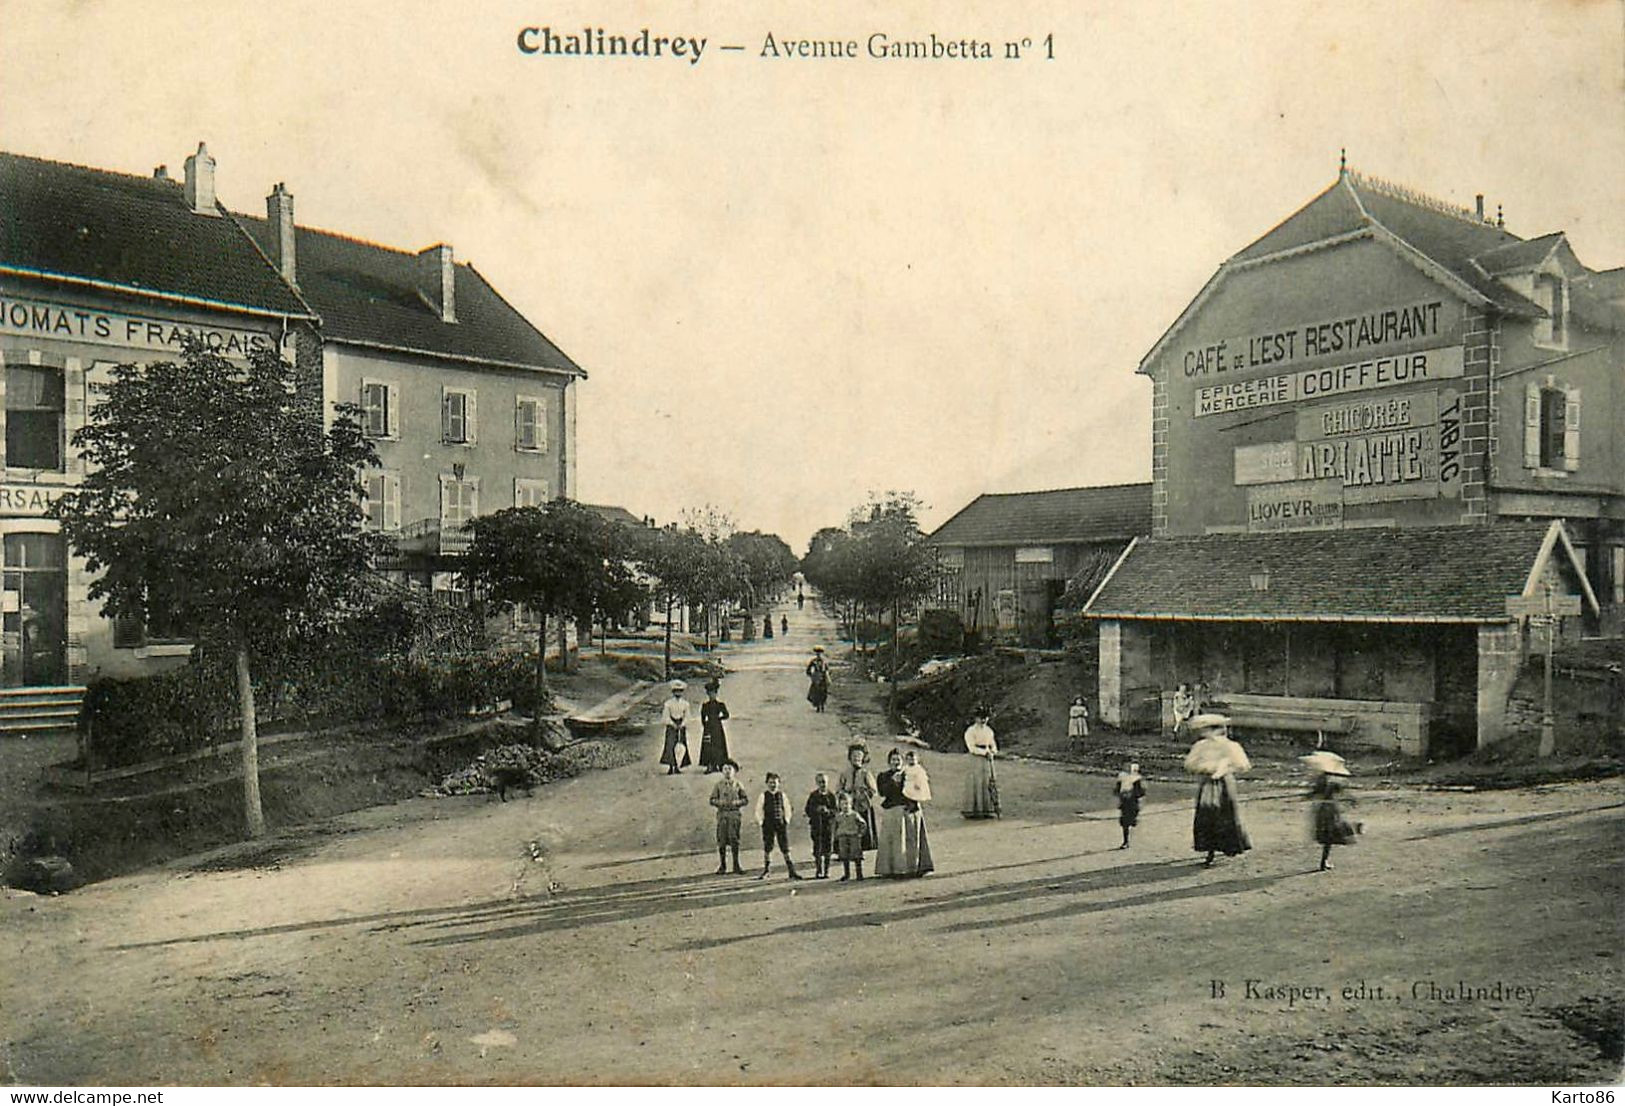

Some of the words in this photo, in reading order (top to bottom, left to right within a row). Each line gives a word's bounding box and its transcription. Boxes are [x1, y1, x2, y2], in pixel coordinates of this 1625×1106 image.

[1184, 340, 1227, 377] CAFÉ
[1250, 331, 1297, 366] L'EST
[1305, 301, 1442, 357] RESTAURANT
[1201, 376, 1288, 400] EPICERIE
[1304, 355, 1427, 395] COIFFEUR
[1201, 389, 1288, 413] MERCERIE
[1322, 400, 1411, 436] CHICORÉE
[1301, 431, 1422, 487] ARLATTE
[1440, 397, 1461, 483] TABAC
